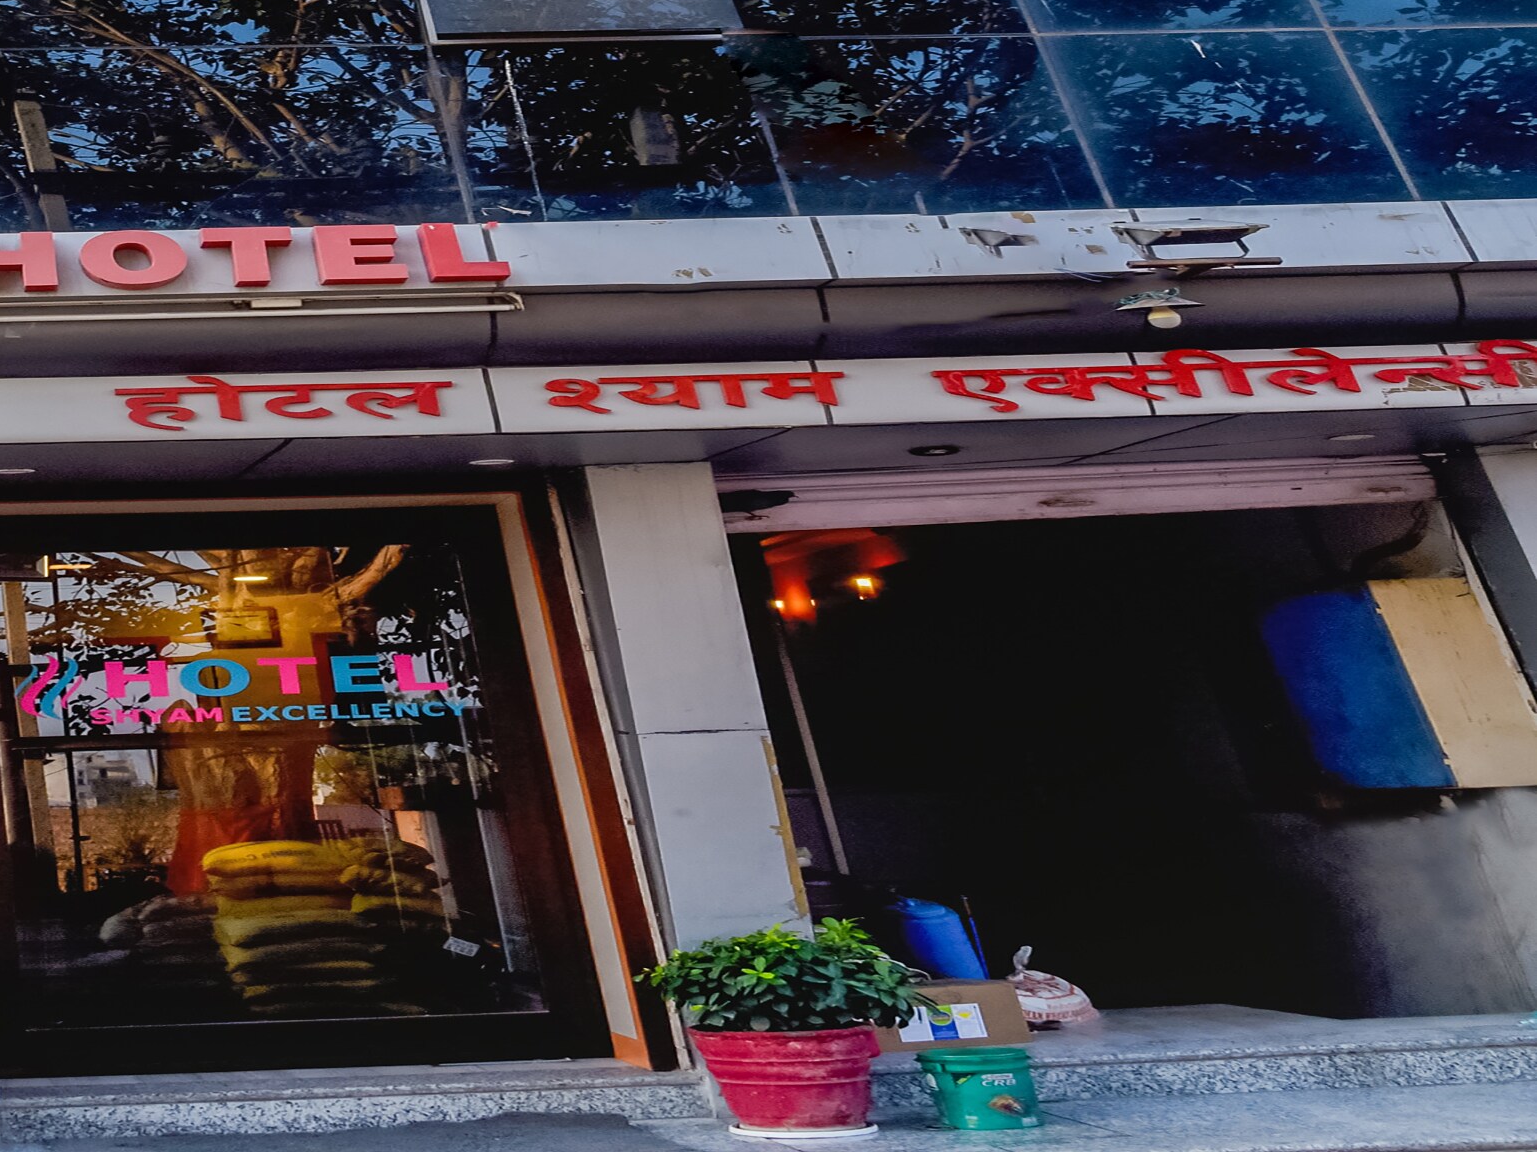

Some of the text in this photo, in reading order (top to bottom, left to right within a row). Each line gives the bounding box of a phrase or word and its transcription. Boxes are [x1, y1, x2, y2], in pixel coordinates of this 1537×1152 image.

[115, 375, 454, 431] होटल
[544, 370, 845, 416] श्याम
[104, 654, 449, 700] HOTEL
[90, 701, 468, 726] SHYAM EXCELLENCY
